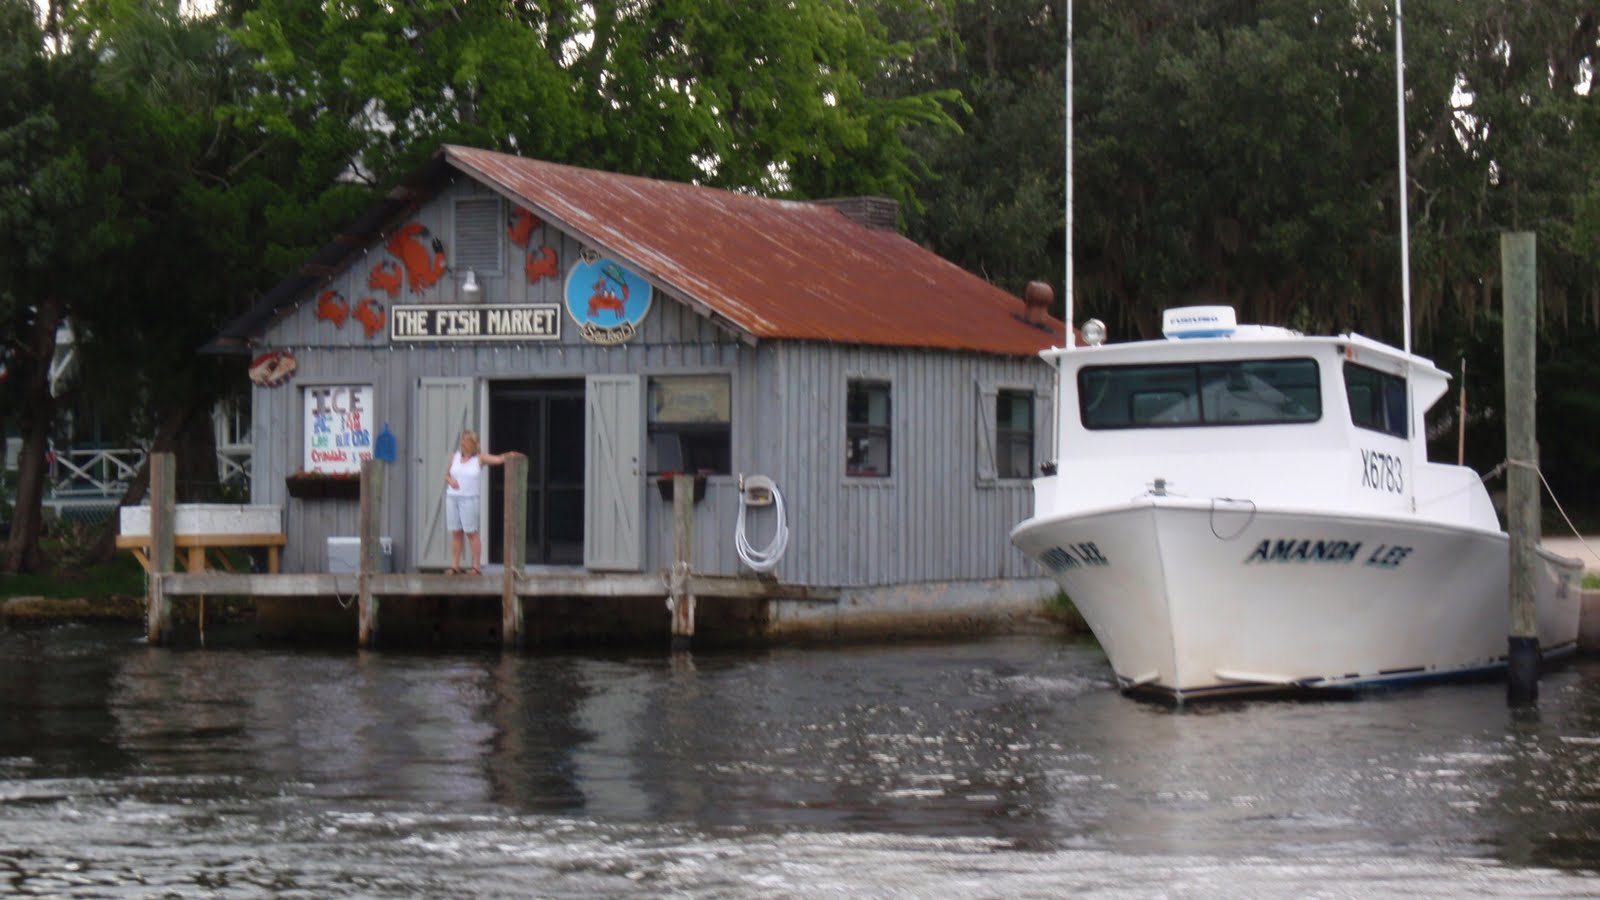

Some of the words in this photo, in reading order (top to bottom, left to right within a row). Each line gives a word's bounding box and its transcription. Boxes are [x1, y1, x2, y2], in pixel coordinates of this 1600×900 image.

[396, 310, 428, 335] THE
[436, 310, 480, 335] FISH
[487, 309, 555, 335] MARKET
[311, 387, 363, 415] ICE
[1360, 448, 1403, 494] X6783
[1069, 541, 1109, 567] LEE
[1244, 539, 1362, 564] AMANDA
[1364, 544, 1413, 569] LEE
